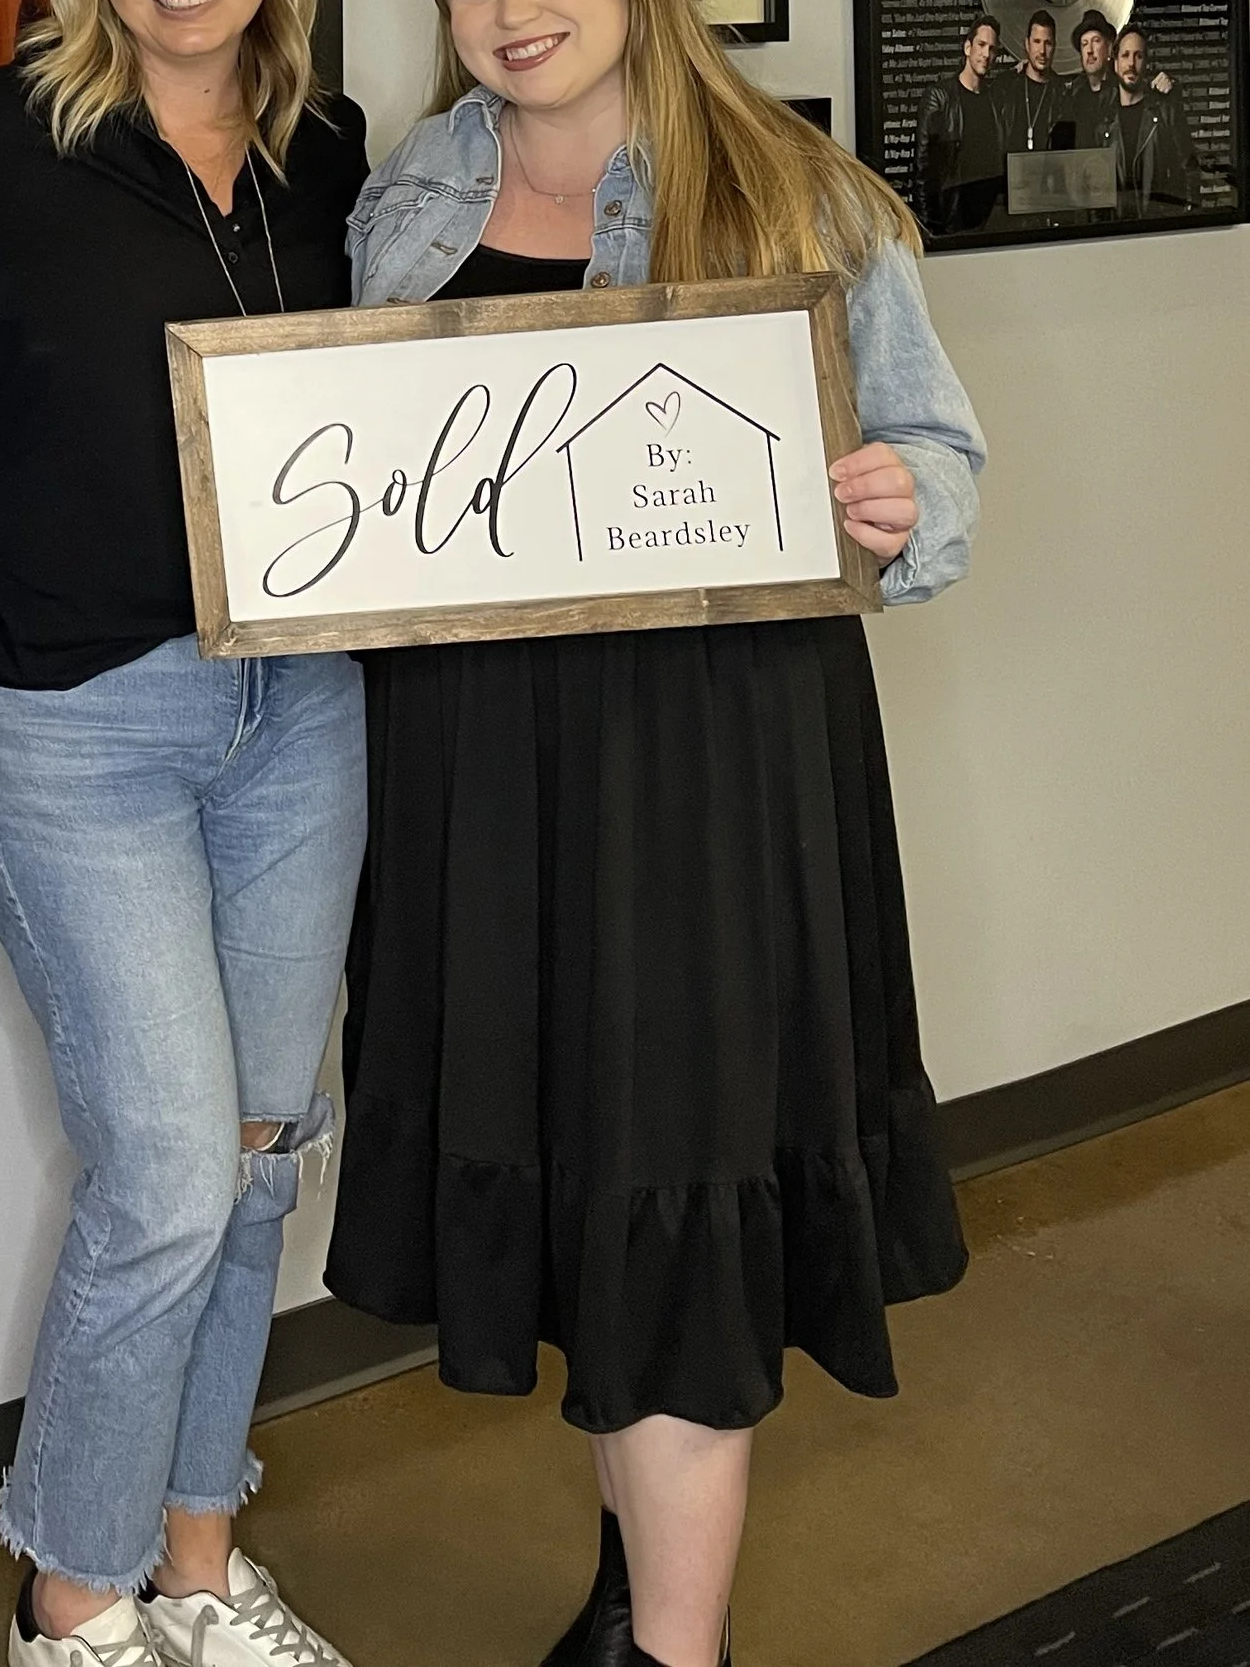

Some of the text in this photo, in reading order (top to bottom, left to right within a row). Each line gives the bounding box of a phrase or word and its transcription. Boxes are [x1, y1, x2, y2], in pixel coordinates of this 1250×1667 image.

[645, 442, 692, 470] By:
[262, 362, 577, 598] Sold
[631, 480, 718, 509] Sarah
[606, 519, 751, 553] Beardsley
